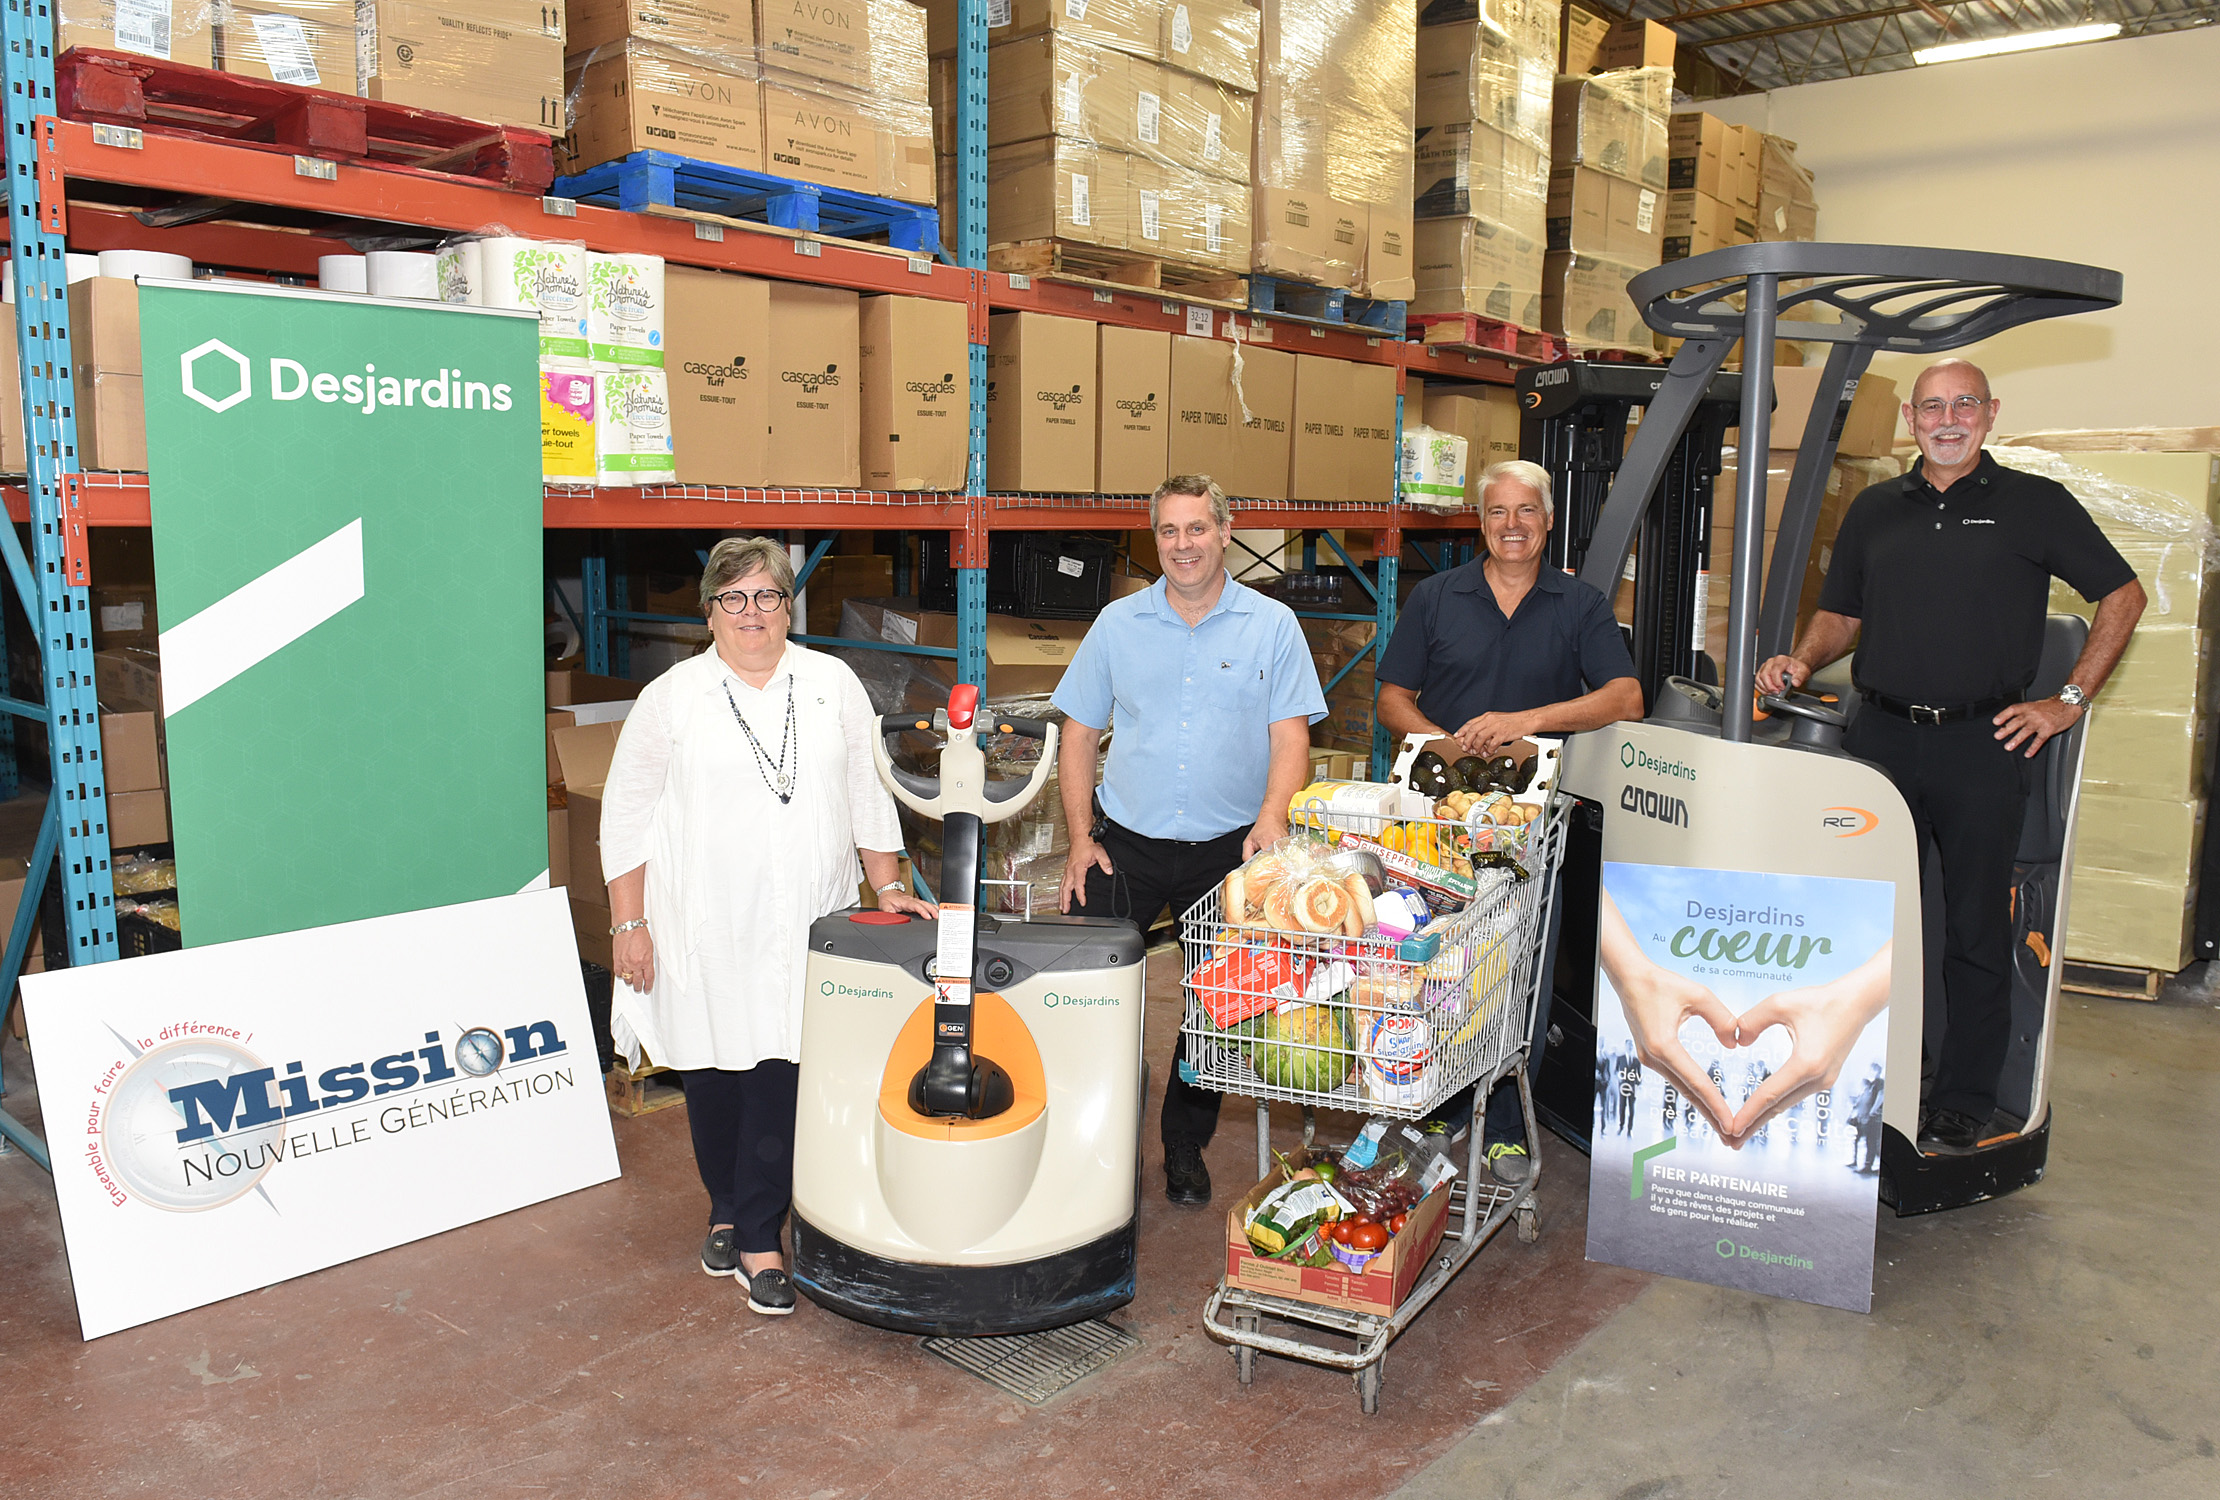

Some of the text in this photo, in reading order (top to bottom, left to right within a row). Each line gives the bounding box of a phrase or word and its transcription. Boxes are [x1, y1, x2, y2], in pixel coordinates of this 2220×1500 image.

[793, 1, 850, 29] AVON
[466, 22, 492, 36] REFLECTS
[668, 78, 732, 105] AVON
[794, 110, 851, 137] AVON
[535, 267, 579, 288] Nature's
[533, 281, 583, 298] Promise
[609, 279, 651, 299] Nature's
[606, 292, 655, 308] Promise
[556, 314, 577, 323] Towels
[1191, 311, 1209, 323] 32-12
[609, 323, 646, 333] Paper Towels
[609, 347, 616, 356] 6
[684, 361, 748, 380] cascades
[781, 370, 839, 386] cascades
[270, 357, 513, 415] Desjardins
[707, 376, 725, 388] Tuff
[802, 384, 819, 394] Tuff
[906, 380, 956, 394] cascades
[625, 389, 664, 406] Nature's
[699, 394, 736, 405] ESSUIE-TOUT
[922, 393, 937, 402] Tuff
[1037, 390, 1082, 404] cascades
[623, 404, 668, 419] Promise
[796, 401, 829, 410] ESSUIE-TOUT
[1053, 402, 1066, 411] Tuff
[1116, 399, 1157, 412] cascades
[917, 410, 947, 418] ESSUIE-TOUT
[1130, 410, 1142, 418] Tuff
[1181, 410, 1228, 426] PAPER TOWELS
[552, 428, 580, 438] towels
[1264, 418, 1285, 433] TOWELS
[1305, 422, 1344, 436] PAPER TOWELS
[629, 432, 646, 440] Paper
[1353, 427, 1390, 440] PAPER TOWELS
[541, 439, 574, 448] uie-tout
[630, 456, 637, 465] 6
[1638, 749, 1697, 781] Desjardins
[1620, 784, 1689, 829] CROWN
[1823, 816, 1856, 828] RC
[1686, 900, 1805, 928] Desjardins
[1652, 932, 1666, 943] Au
[1692, 963, 1793, 982] de sa communauté
[838, 984, 894, 1000] Desjardins
[1062, 994, 1120, 1009] Desjardins
[159, 1020, 241, 1041] différence
[1387, 1018, 1415, 1030] POM
[136, 1038, 154, 1050] la
[94, 1060, 125, 1094] faire
[168, 1018, 567, 1144] Mission
[87, 1101, 101, 1134] pour
[182, 1067, 575, 1188] NOUVELLE GÉNÉRATION
[85, 1141, 127, 1207] Ensemble
[1652, 1165, 1788, 1198] FIER PARTENAIRE
[1651, 1184, 1805, 1217] Parce que dans chaque communauté
[1650, 1203, 1759, 1230] des gens pour les réaliser.
[1672, 1197, 1687, 1208] des
[1689, 1200, 1714, 1212] rêves,
[1716, 1204, 1731, 1214] des
[1733, 1208, 1764, 1222] projets
[1766, 1213, 1776, 1222] et
[1739, 1245, 1814, 1270] Desjardins
